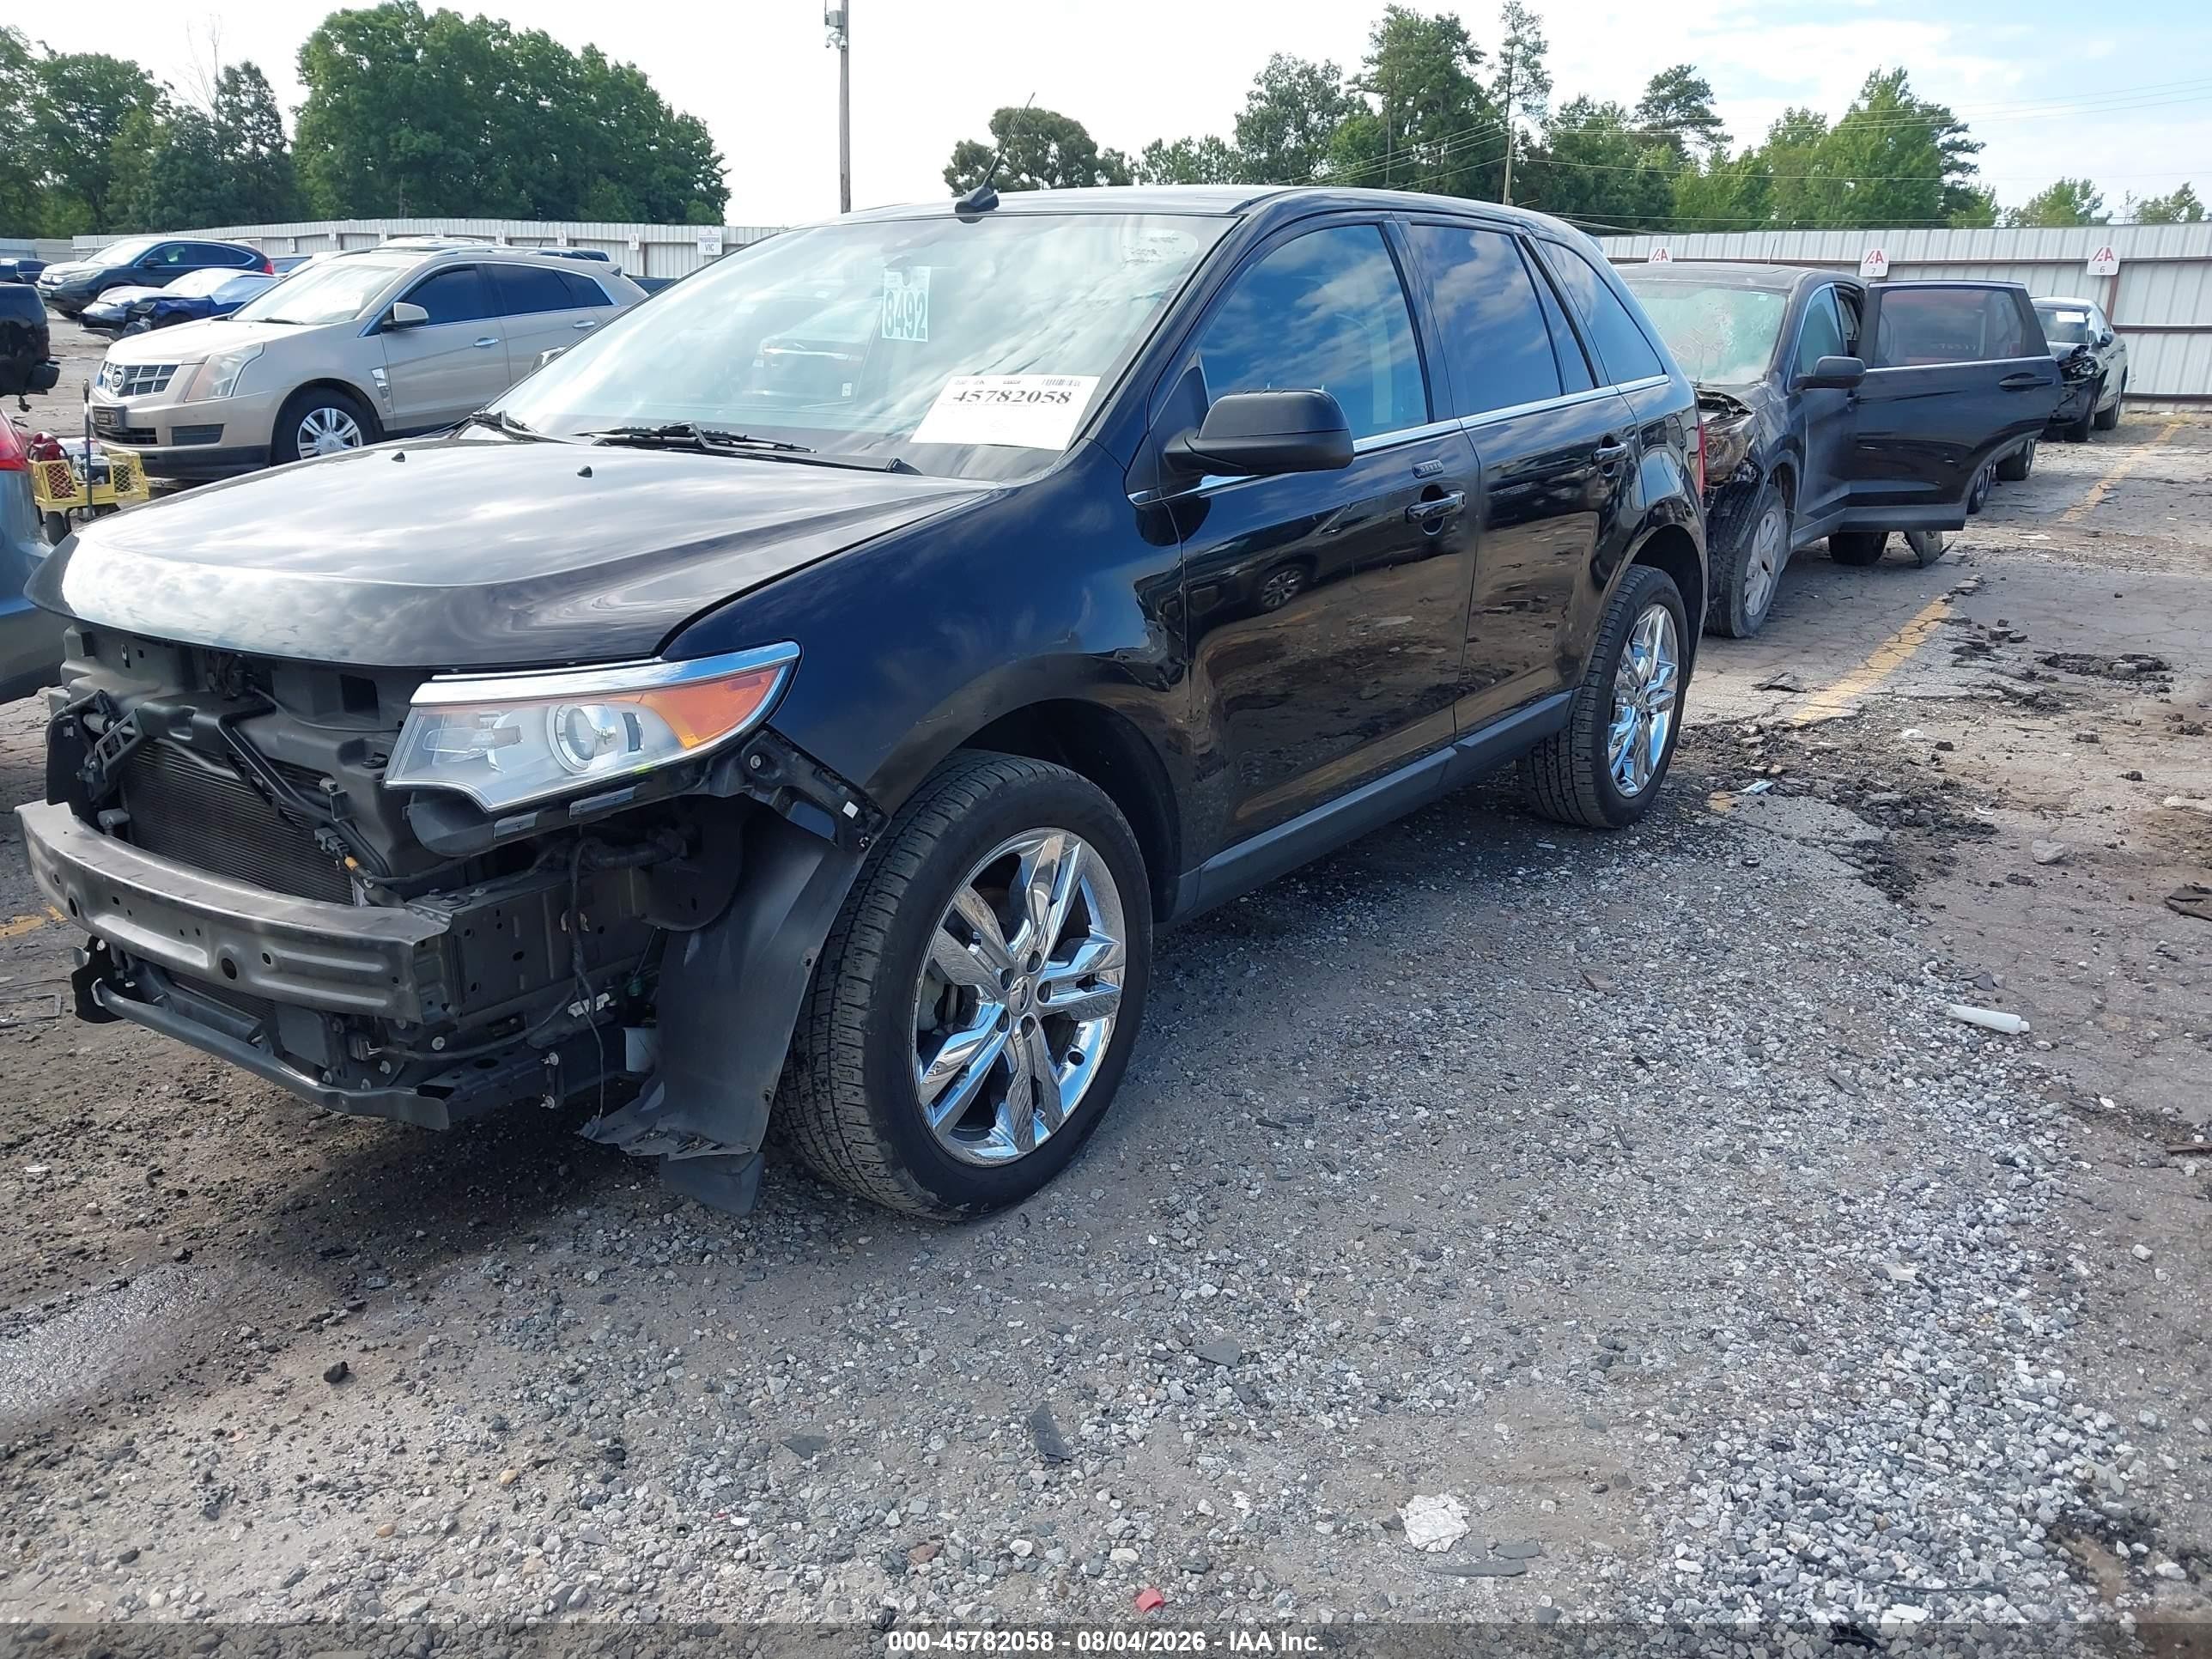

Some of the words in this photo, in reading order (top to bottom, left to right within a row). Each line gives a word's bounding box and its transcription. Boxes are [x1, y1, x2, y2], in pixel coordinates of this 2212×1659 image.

[2100, 265, 2106, 274] 6
[884, 290, 926, 338] 8492
[952, 390, 1073, 404] 45782058
